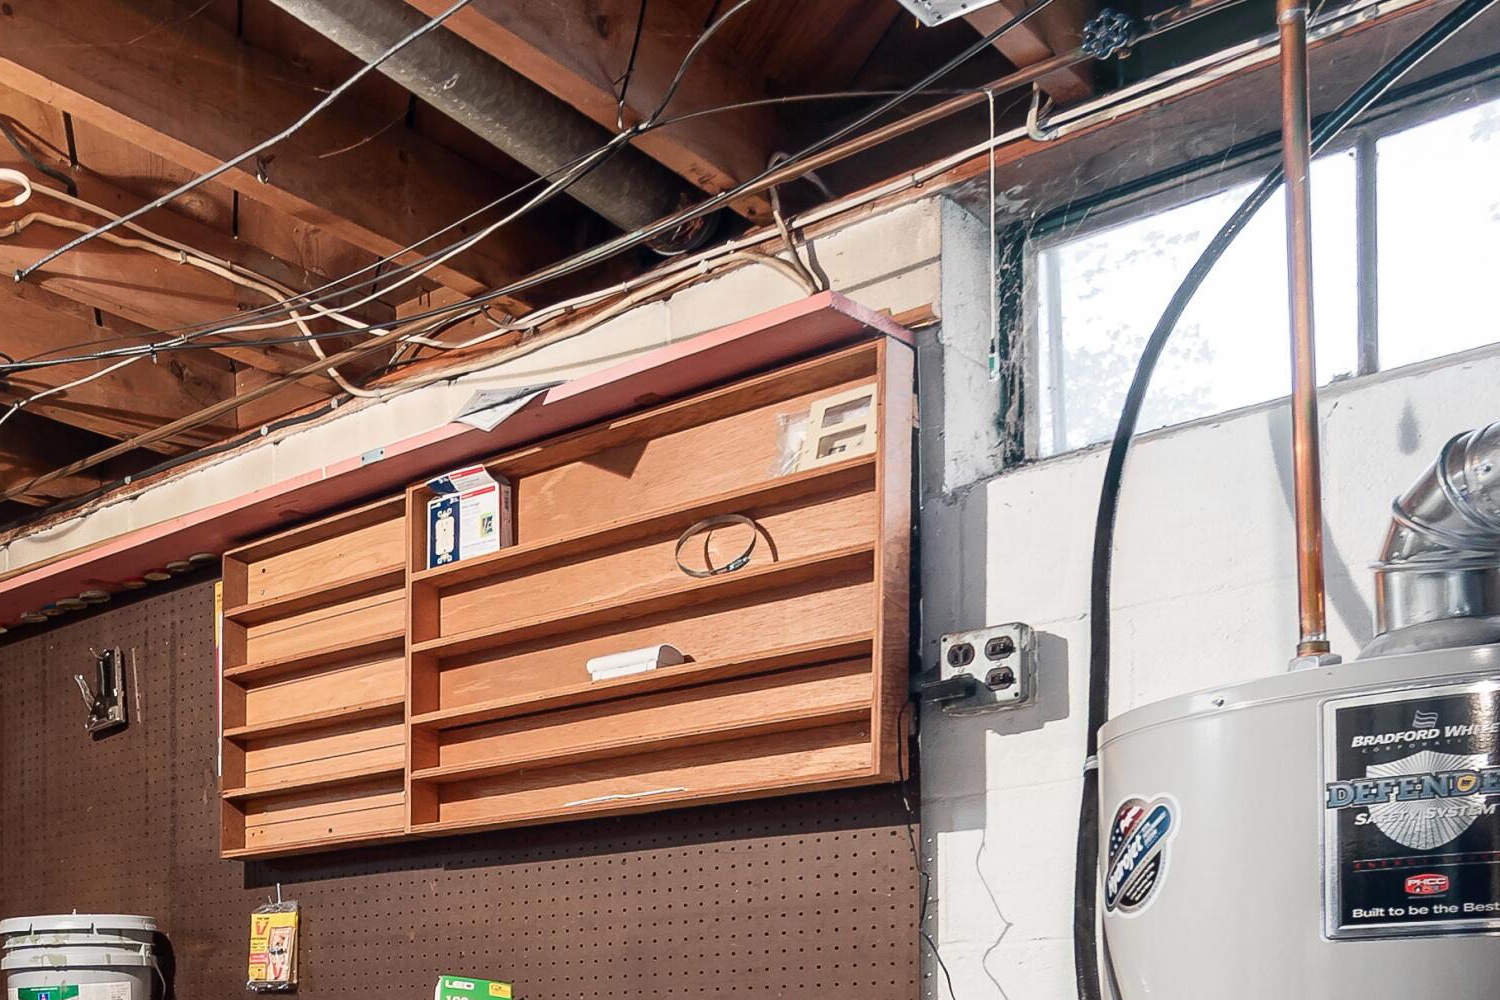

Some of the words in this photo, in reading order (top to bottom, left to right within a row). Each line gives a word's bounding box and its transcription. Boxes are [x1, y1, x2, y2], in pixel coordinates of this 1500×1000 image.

[1351, 728, 1441, 748] BRADFORD
[1326, 769, 1500, 809] DEFENDE
[1425, 803, 1496, 819] SYSTEM
[1407, 877, 1447, 887] PHCC
[1352, 908, 1385, 918] Built
[1388, 908, 1405, 916] to
[1408, 906, 1429, 915] be
[1433, 904, 1459, 914] the
[1463, 902, 1500, 912] Best
[445, 979, 475, 990] LED
